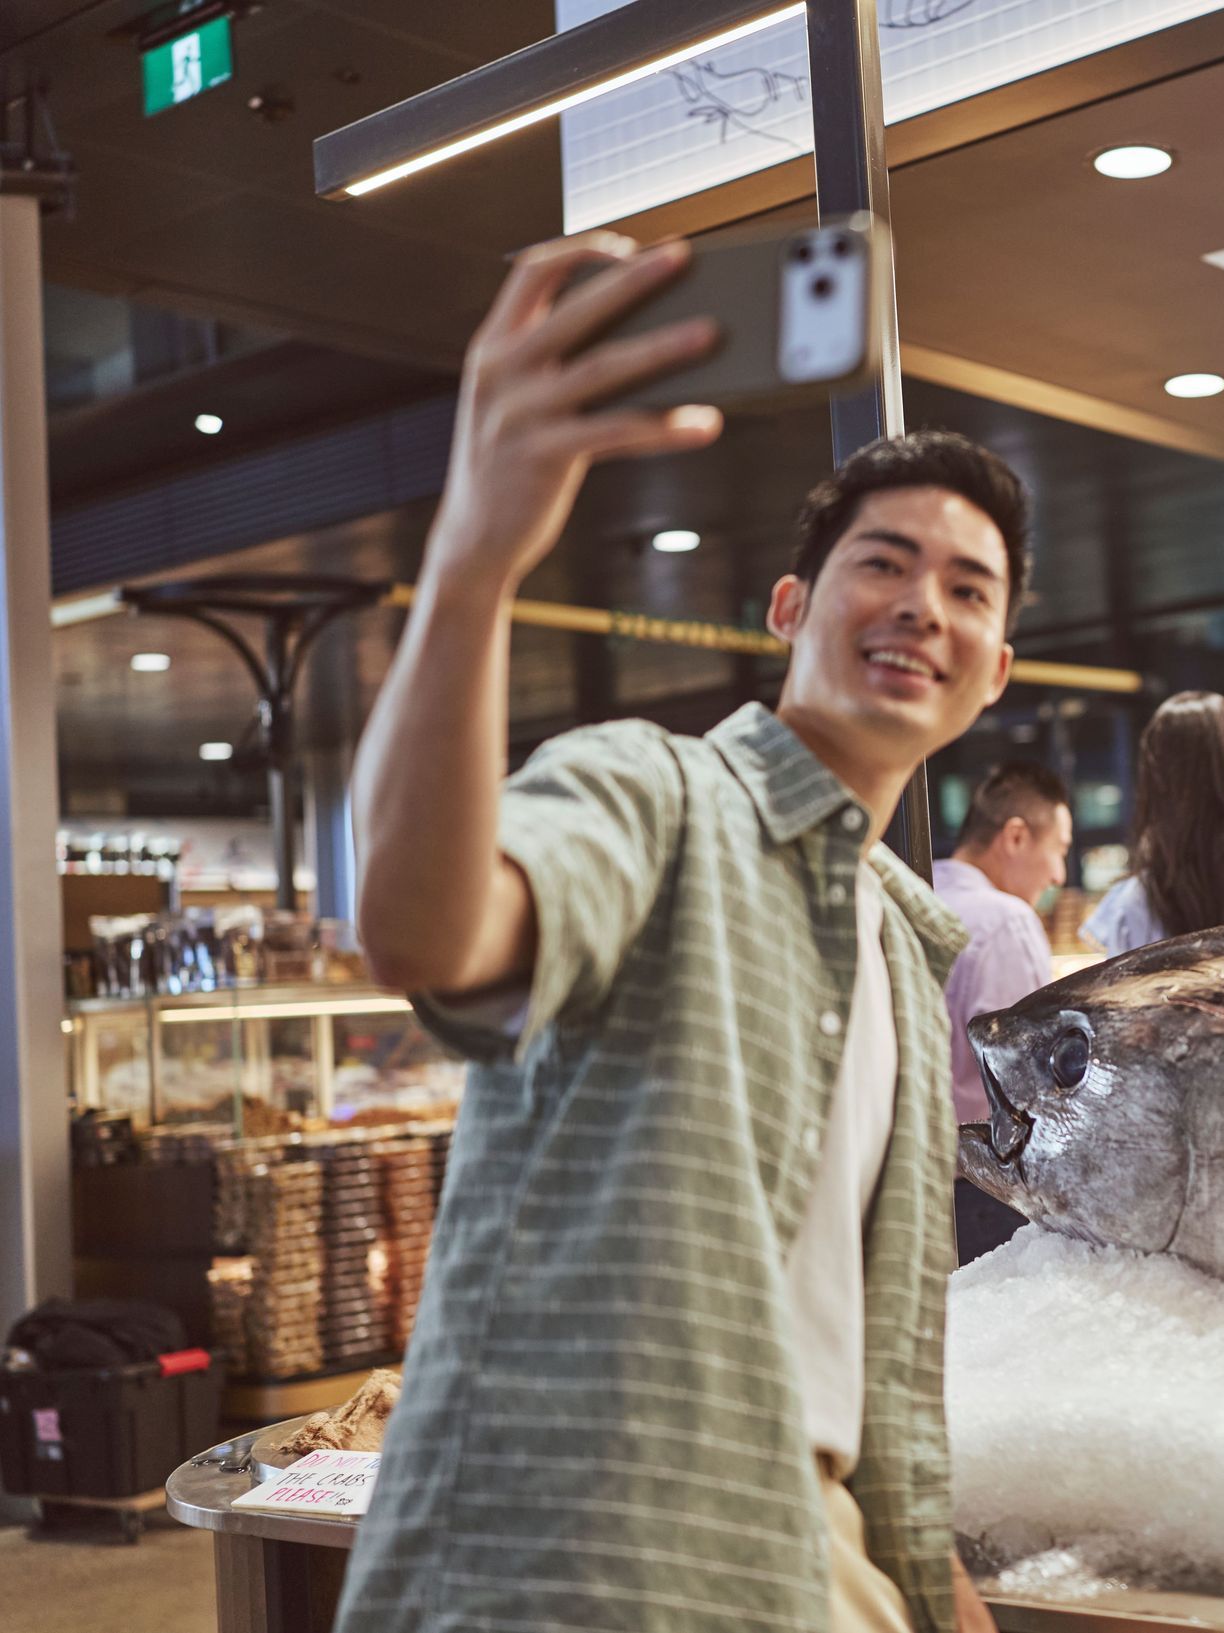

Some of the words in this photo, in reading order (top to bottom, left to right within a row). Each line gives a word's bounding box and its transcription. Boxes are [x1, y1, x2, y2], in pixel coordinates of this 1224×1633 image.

[297, 1453, 330, 1468] DO
[331, 1456, 369, 1469] NOT
[276, 1472, 317, 1485] THE
[316, 1473, 375, 1486] CRABS
